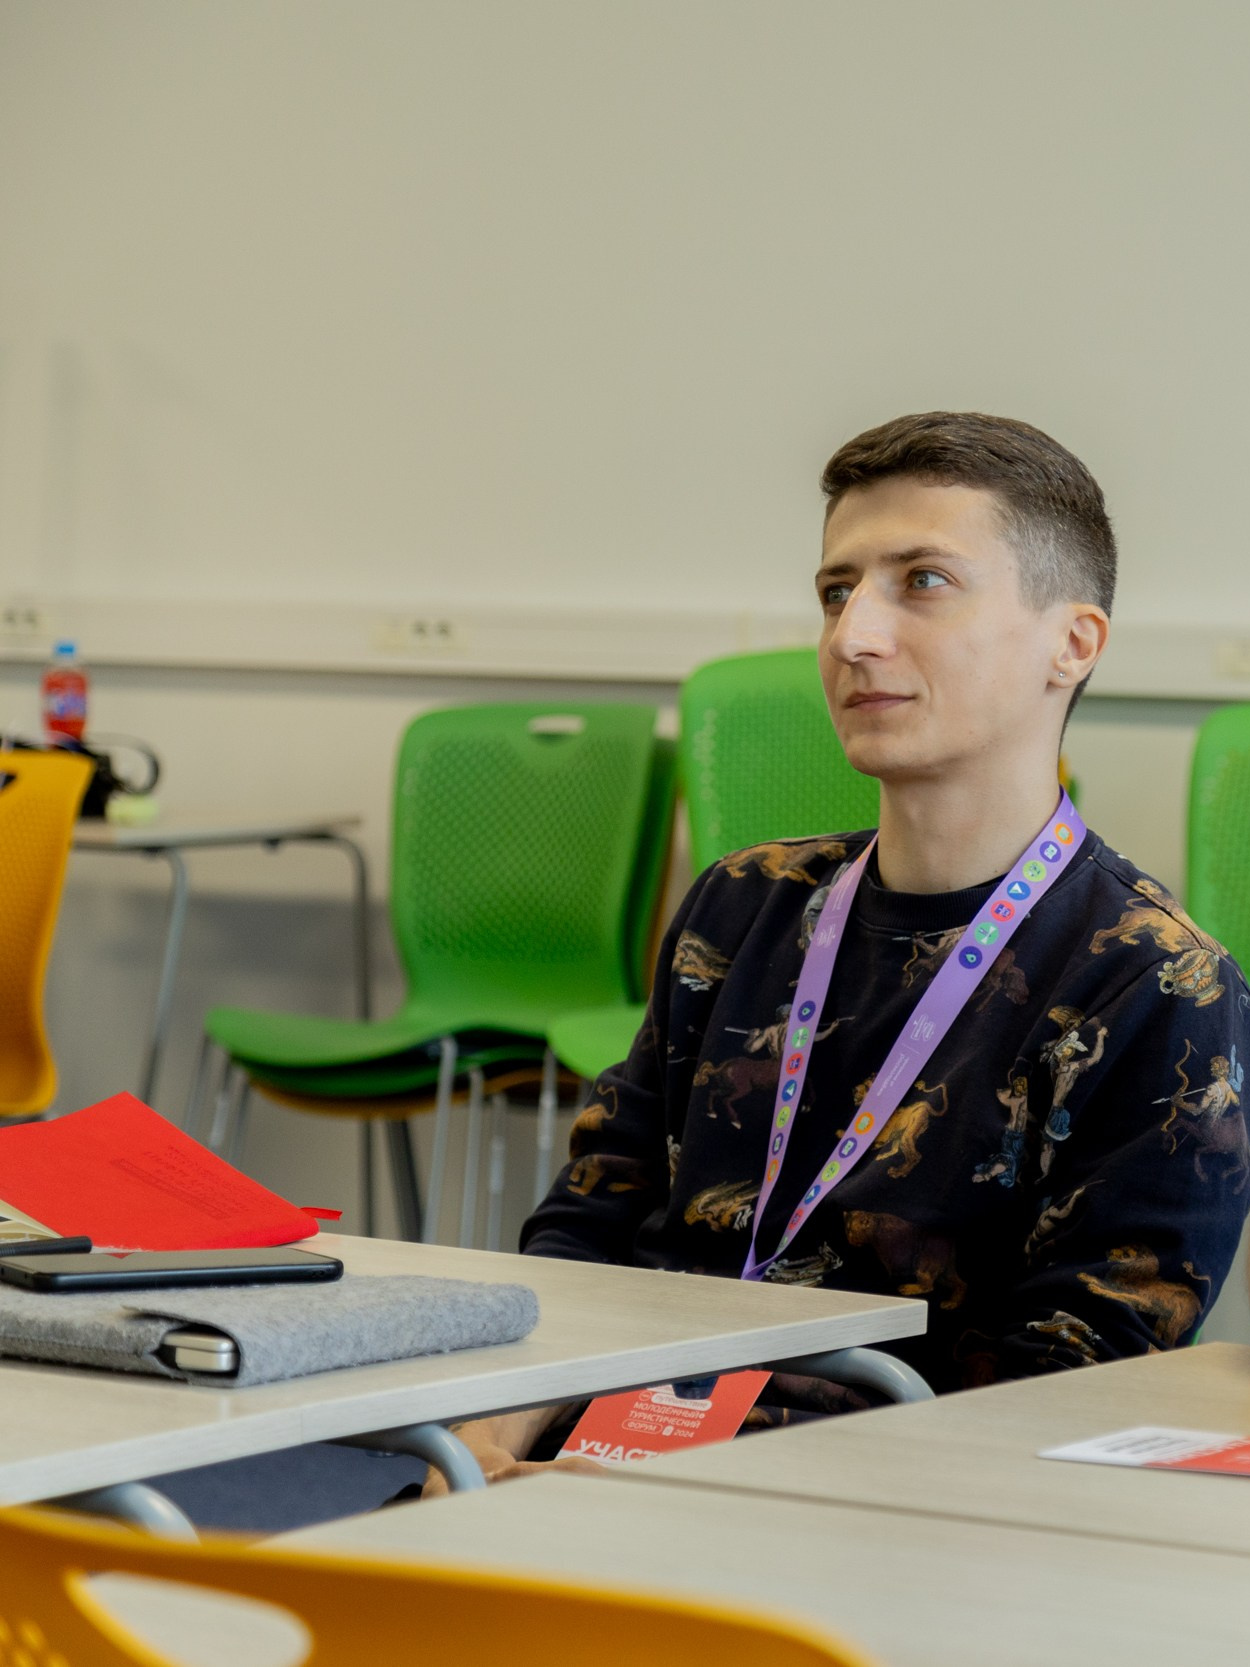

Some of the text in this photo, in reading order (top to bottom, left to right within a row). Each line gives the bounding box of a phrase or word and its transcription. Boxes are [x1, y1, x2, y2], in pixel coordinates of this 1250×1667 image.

[628, 1410, 701, 1429] ТУРИСТИЧЕСКИЙ
[627, 1421, 695, 1438] ФОРУМ 2024
[576, 1438, 662, 1461] УЧАСТ
